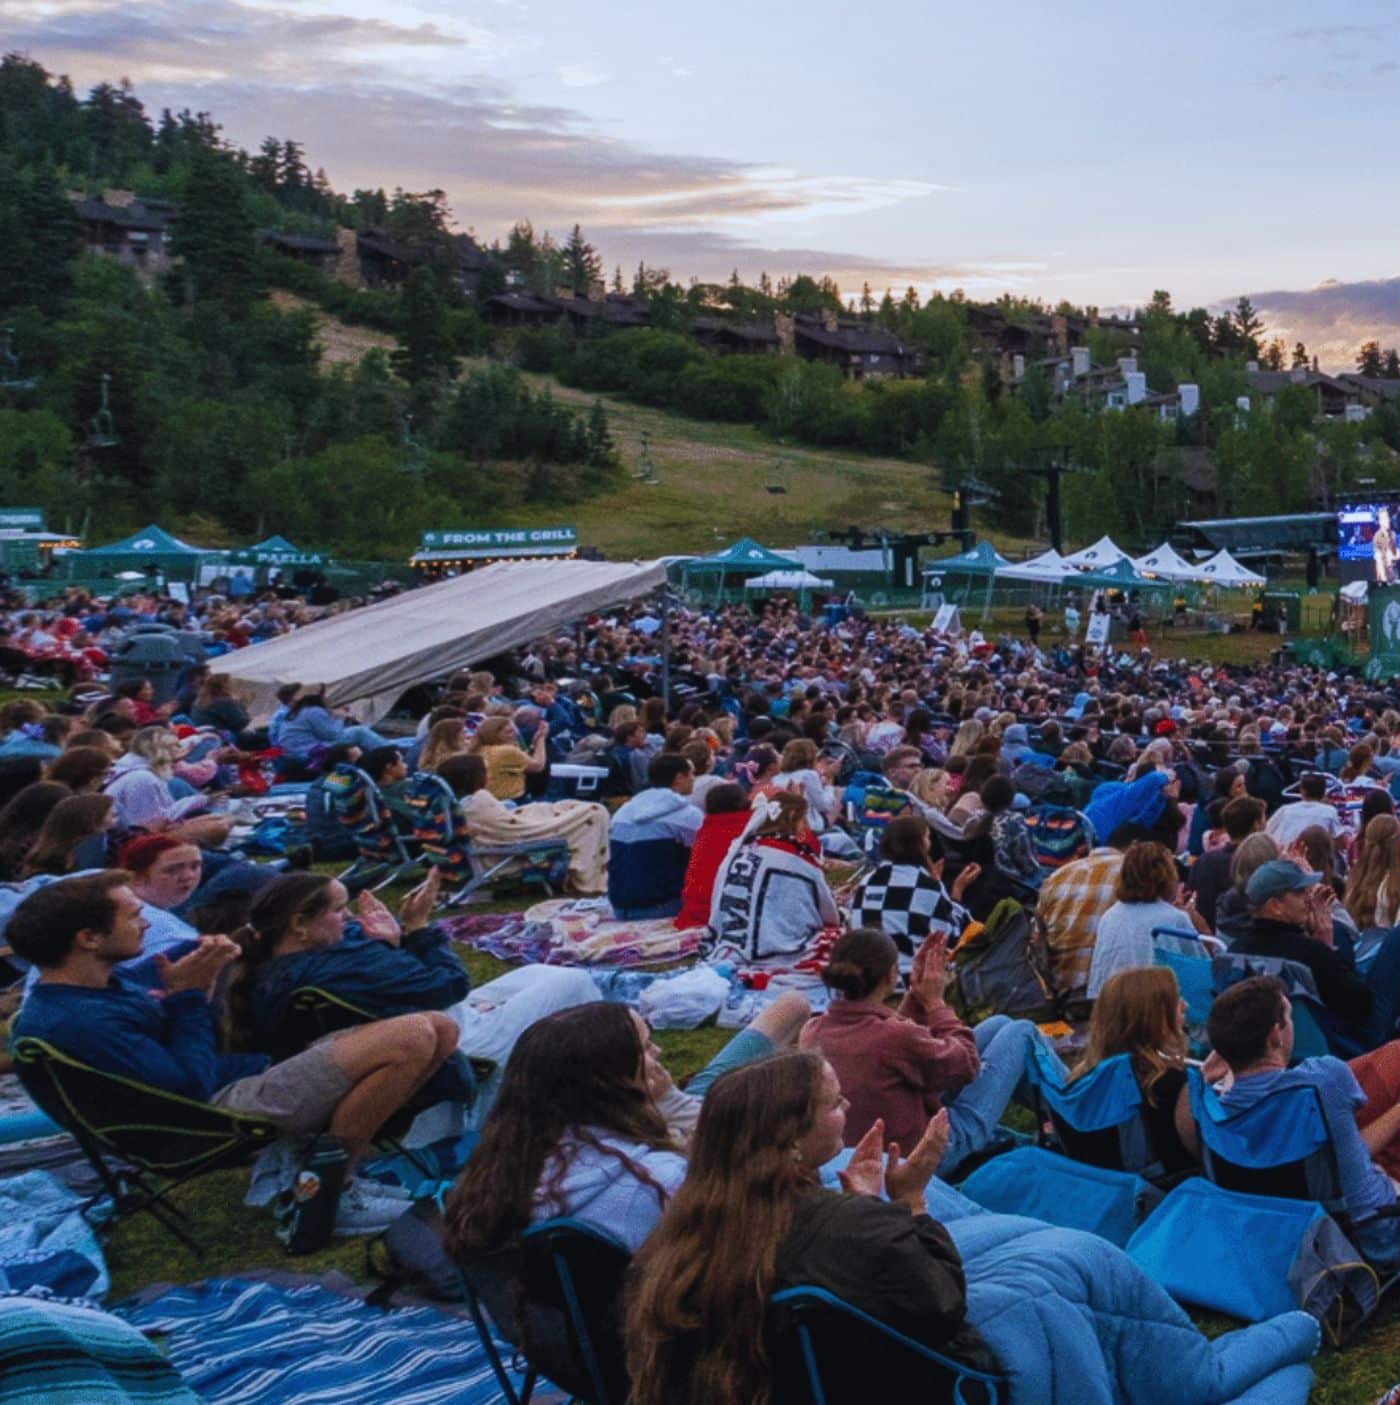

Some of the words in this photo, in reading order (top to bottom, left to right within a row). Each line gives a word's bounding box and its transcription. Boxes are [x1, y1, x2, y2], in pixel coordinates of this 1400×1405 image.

[443, 533, 490, 544] FROM
[494, 532, 526, 542] THE
[530, 529, 576, 541] GRILL
[257, 553, 321, 565] PAELLA
